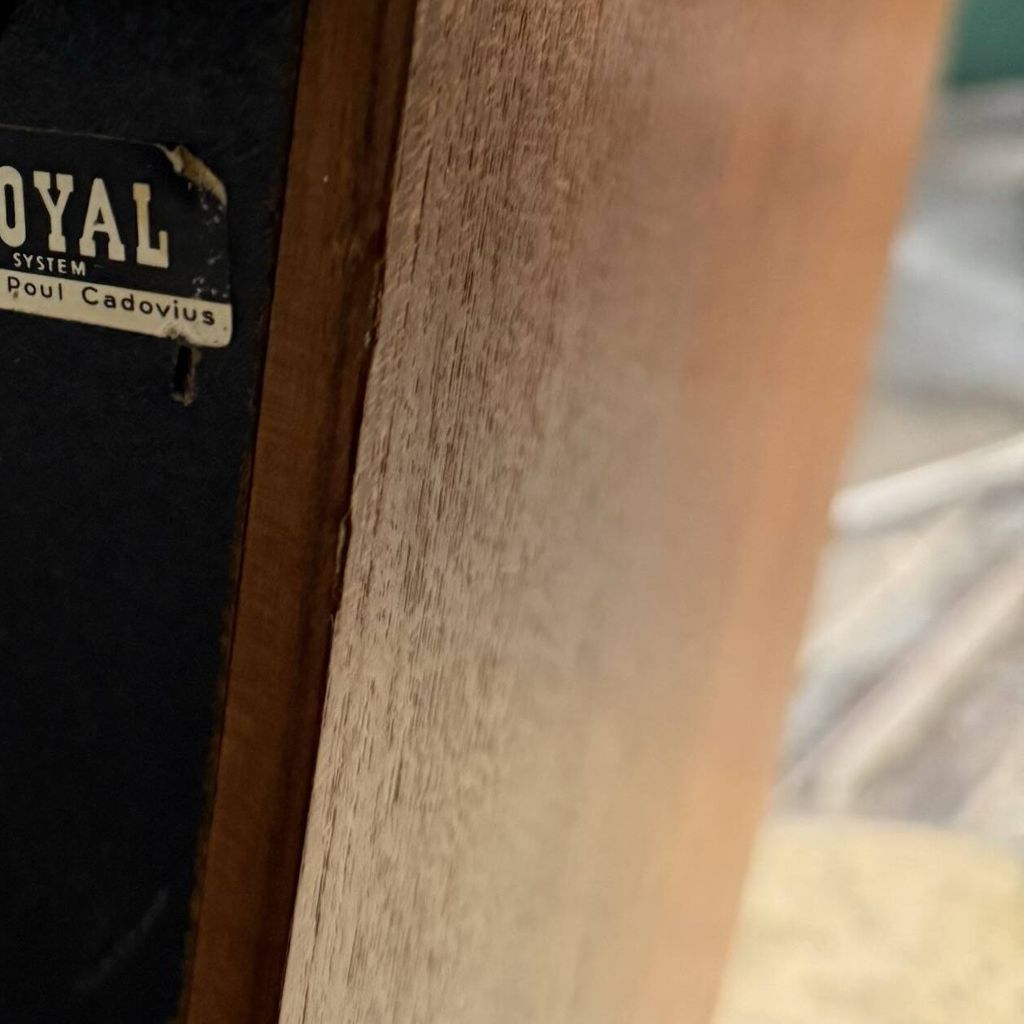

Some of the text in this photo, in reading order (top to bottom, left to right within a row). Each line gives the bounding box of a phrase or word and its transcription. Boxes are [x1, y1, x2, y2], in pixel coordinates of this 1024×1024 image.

[12, 252, 87, 277] SYSTEM
[7, 276, 63, 301] Poul
[82, 286, 216, 326] Cadovius
